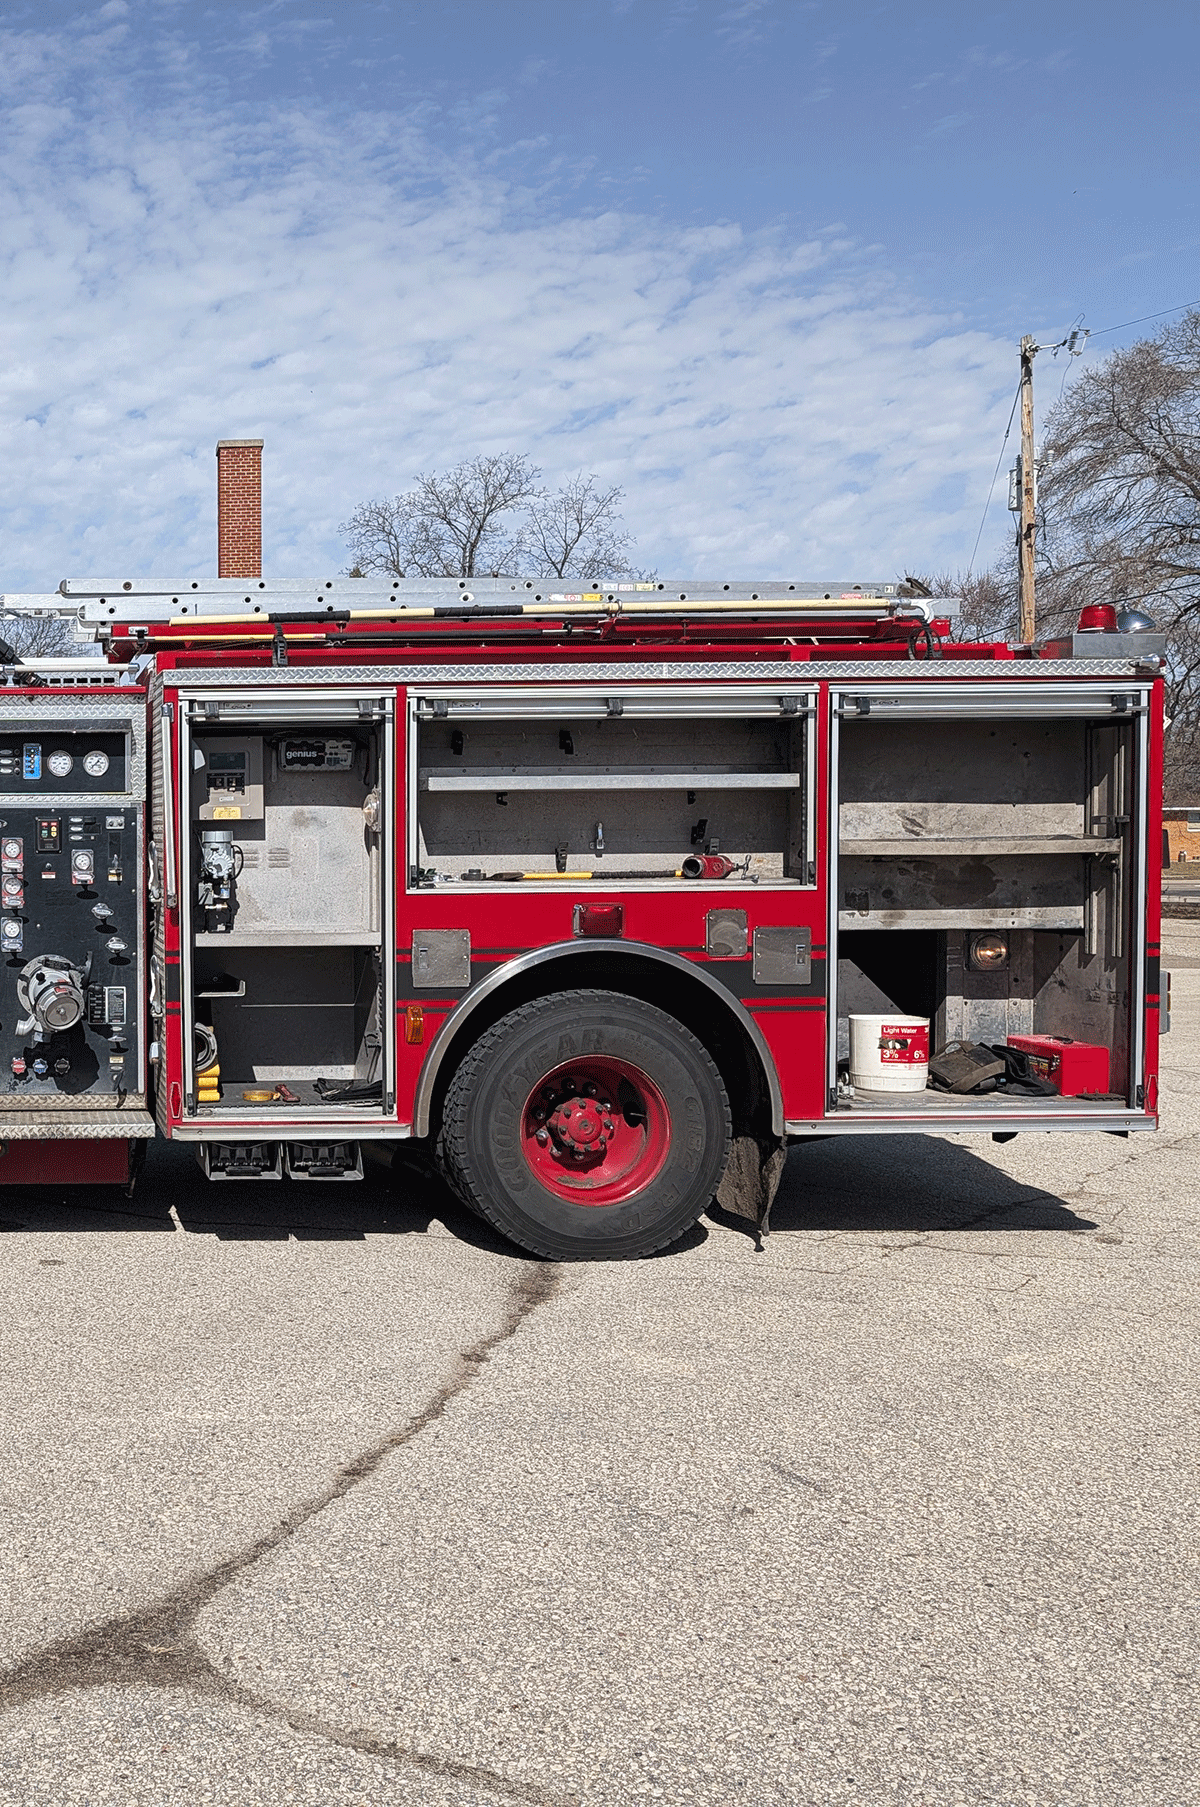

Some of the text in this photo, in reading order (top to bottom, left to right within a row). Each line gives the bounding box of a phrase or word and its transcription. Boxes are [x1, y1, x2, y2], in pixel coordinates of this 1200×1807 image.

[286, 751, 317, 759] genius
[883, 1050, 899, 1059] 3%
[914, 1050, 925, 1059] 6%
[492, 1028, 604, 1193] GOODYEAR
